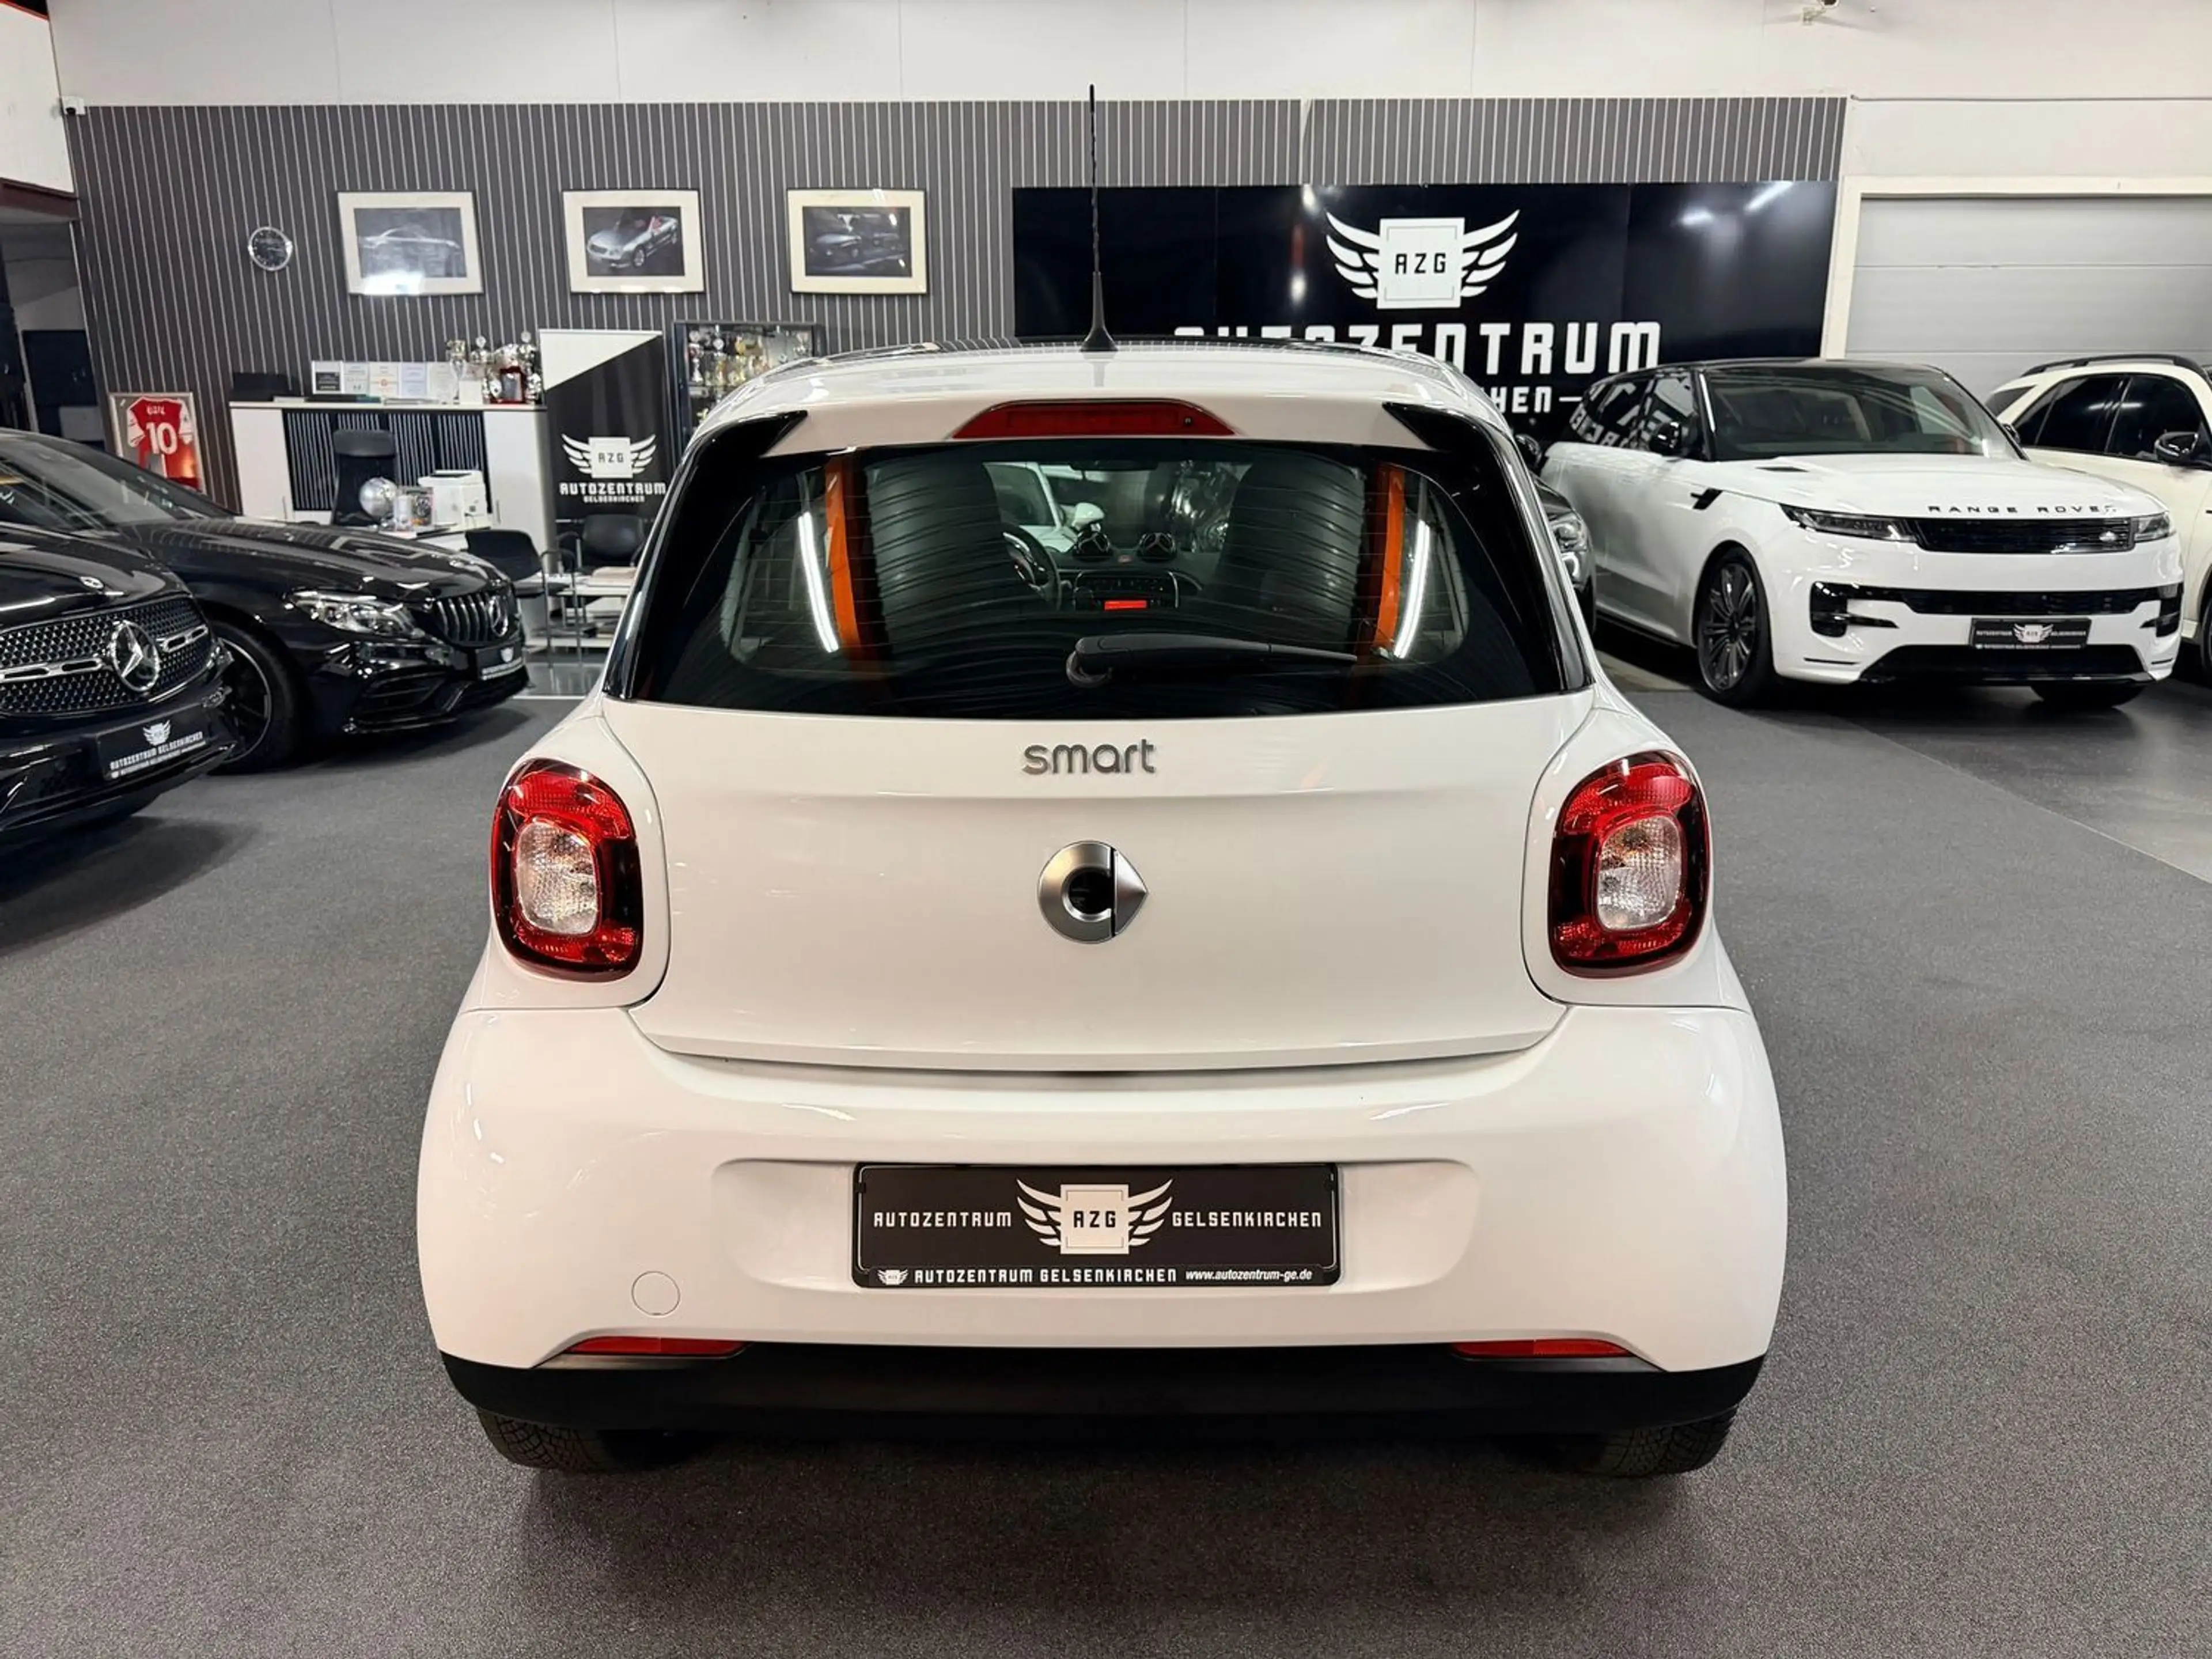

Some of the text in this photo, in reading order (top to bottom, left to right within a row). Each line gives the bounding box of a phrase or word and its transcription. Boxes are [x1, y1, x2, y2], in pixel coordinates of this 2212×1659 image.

[1395, 252, 1446, 274] AZG
[1175, 321, 1661, 375] ENTRUM
[146, 422, 178, 455] 10
[598, 452, 624, 463] AZG
[559, 482, 666, 495] AUTOZENTRUM
[1022, 738, 1155, 775] smart
[873, 1211, 1321, 1228] AUTOZENTRUM AZG GELSENKIRCHEN
[914, 1269, 1312, 1283] AUTOZENTRUM GELSENKIRCHEN www.autozentrum-ge.de
